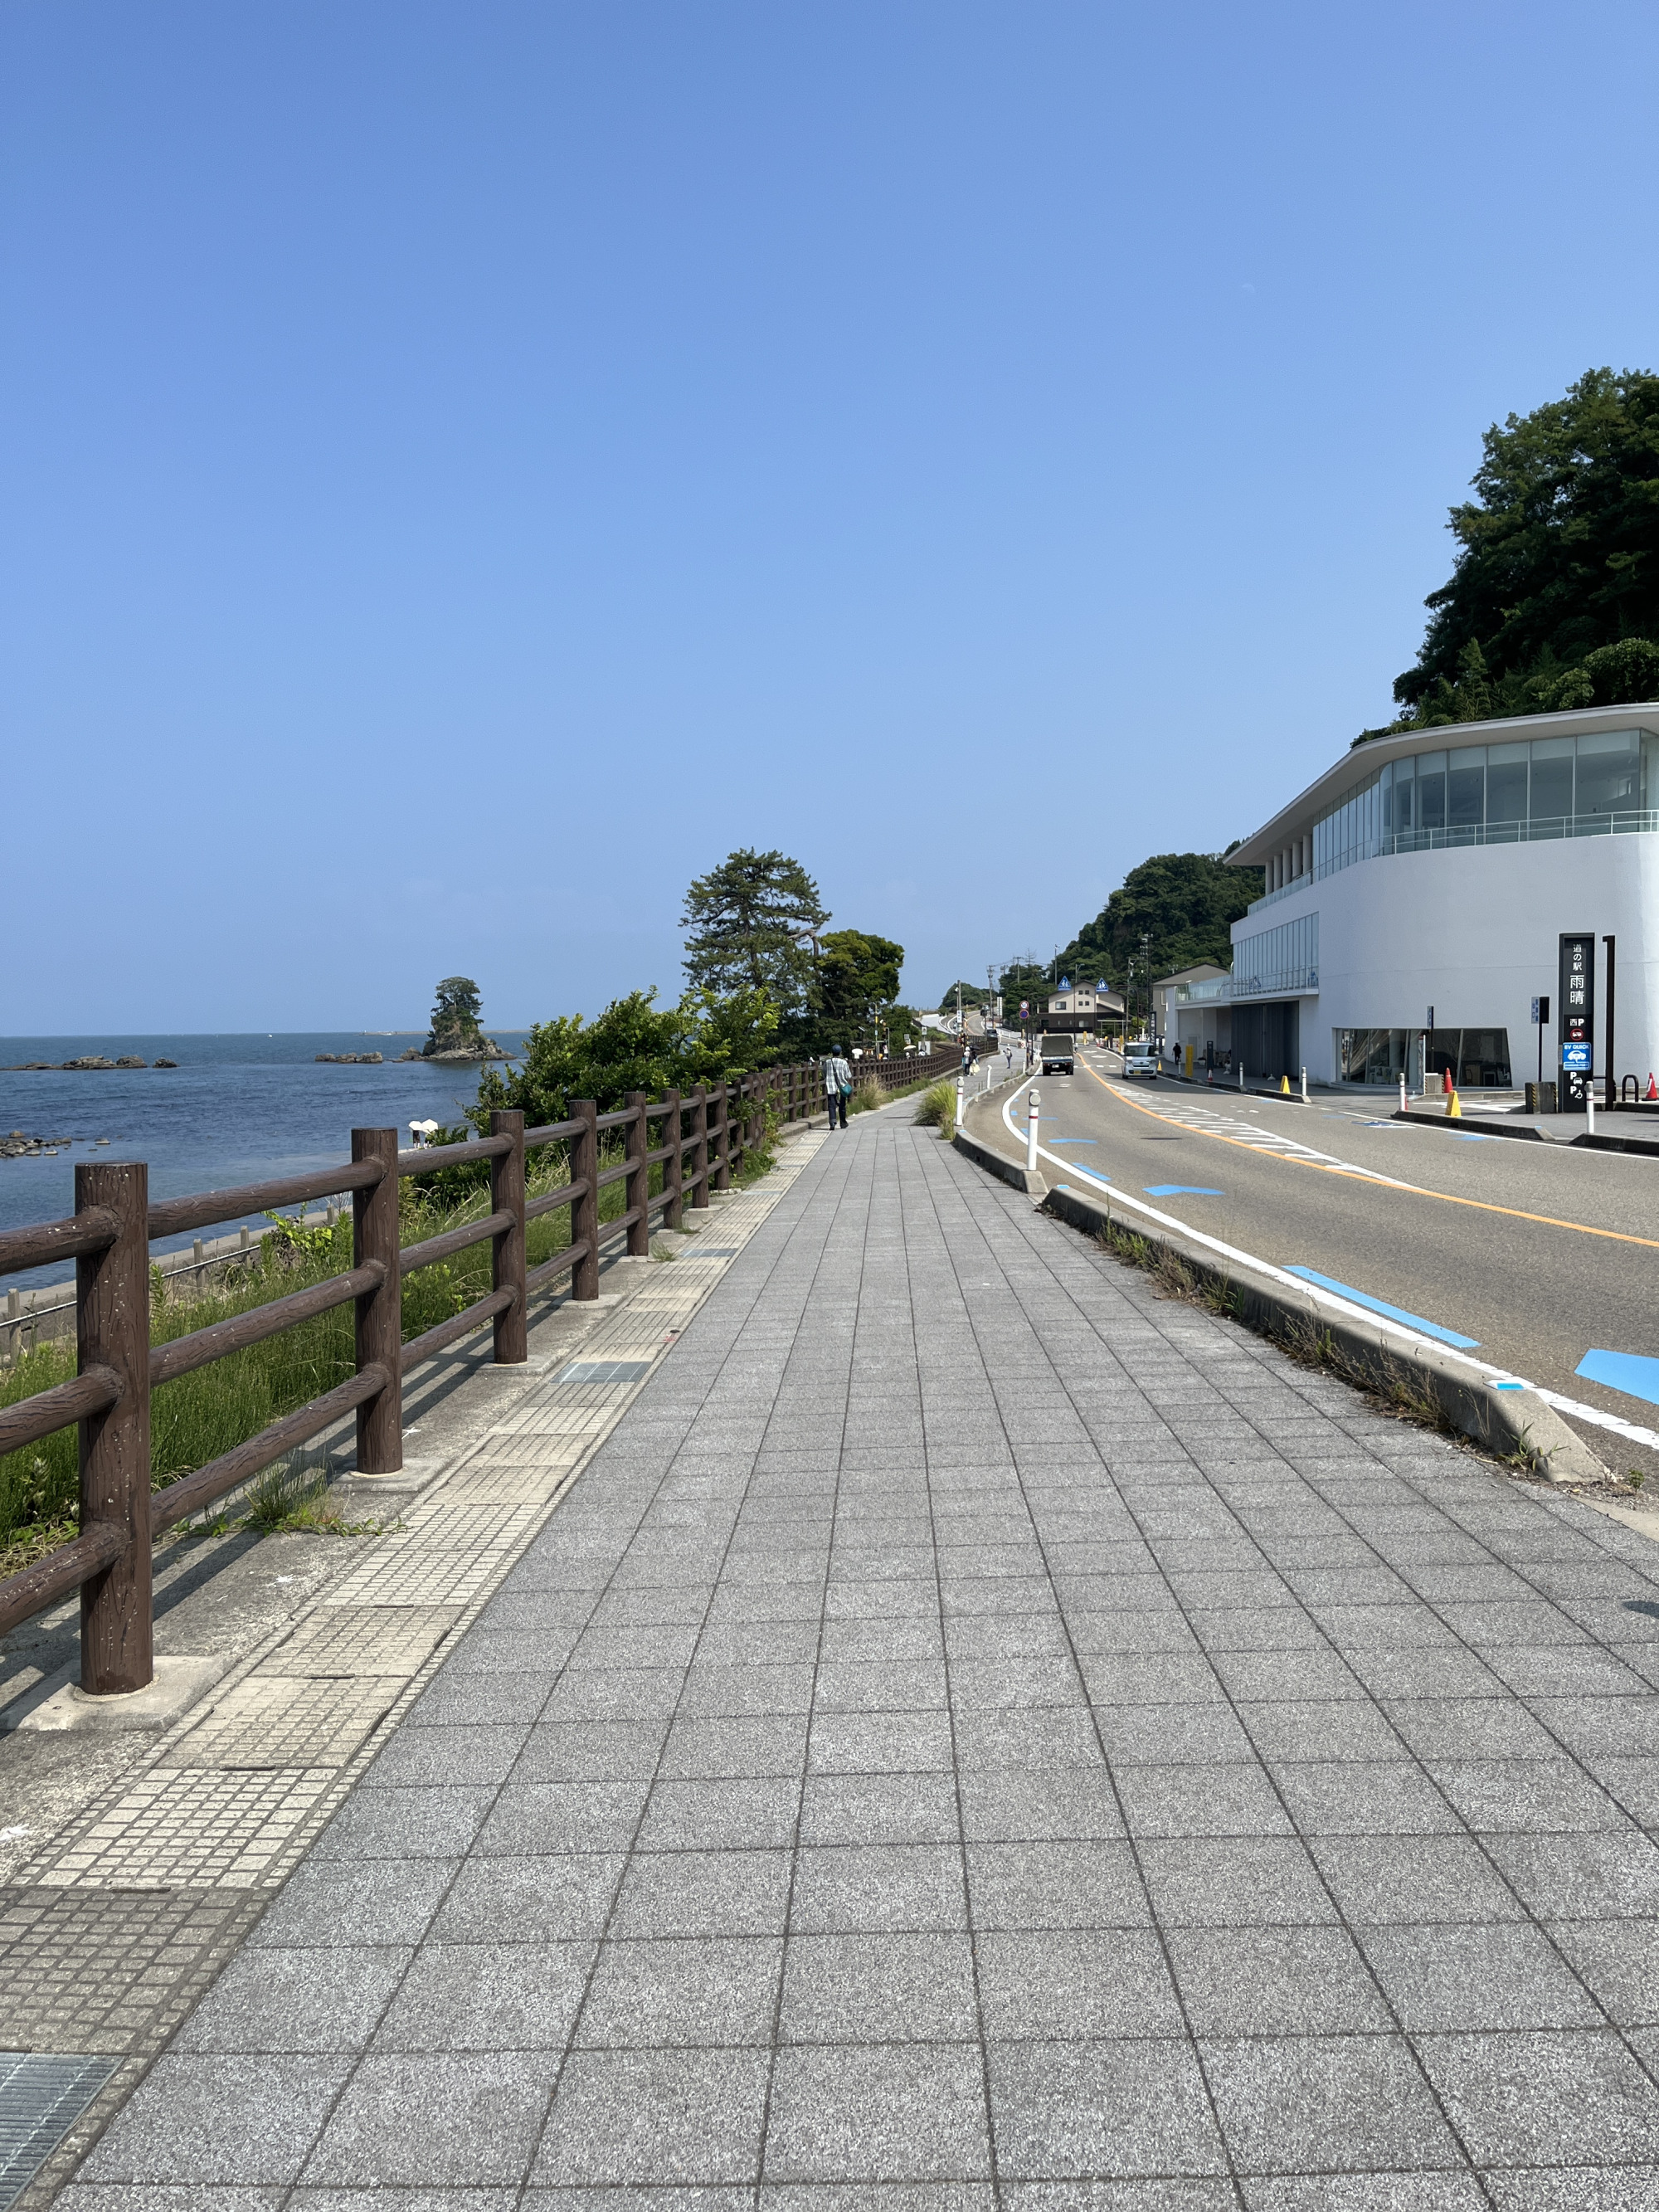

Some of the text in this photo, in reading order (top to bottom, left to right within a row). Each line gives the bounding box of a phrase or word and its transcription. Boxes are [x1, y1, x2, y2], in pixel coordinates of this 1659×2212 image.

[1569, 943, 1585, 1005] 道の駅 雨晴
[1569, 1071, 1578, 1080] P
[1569, 1085, 1578, 1094] P
